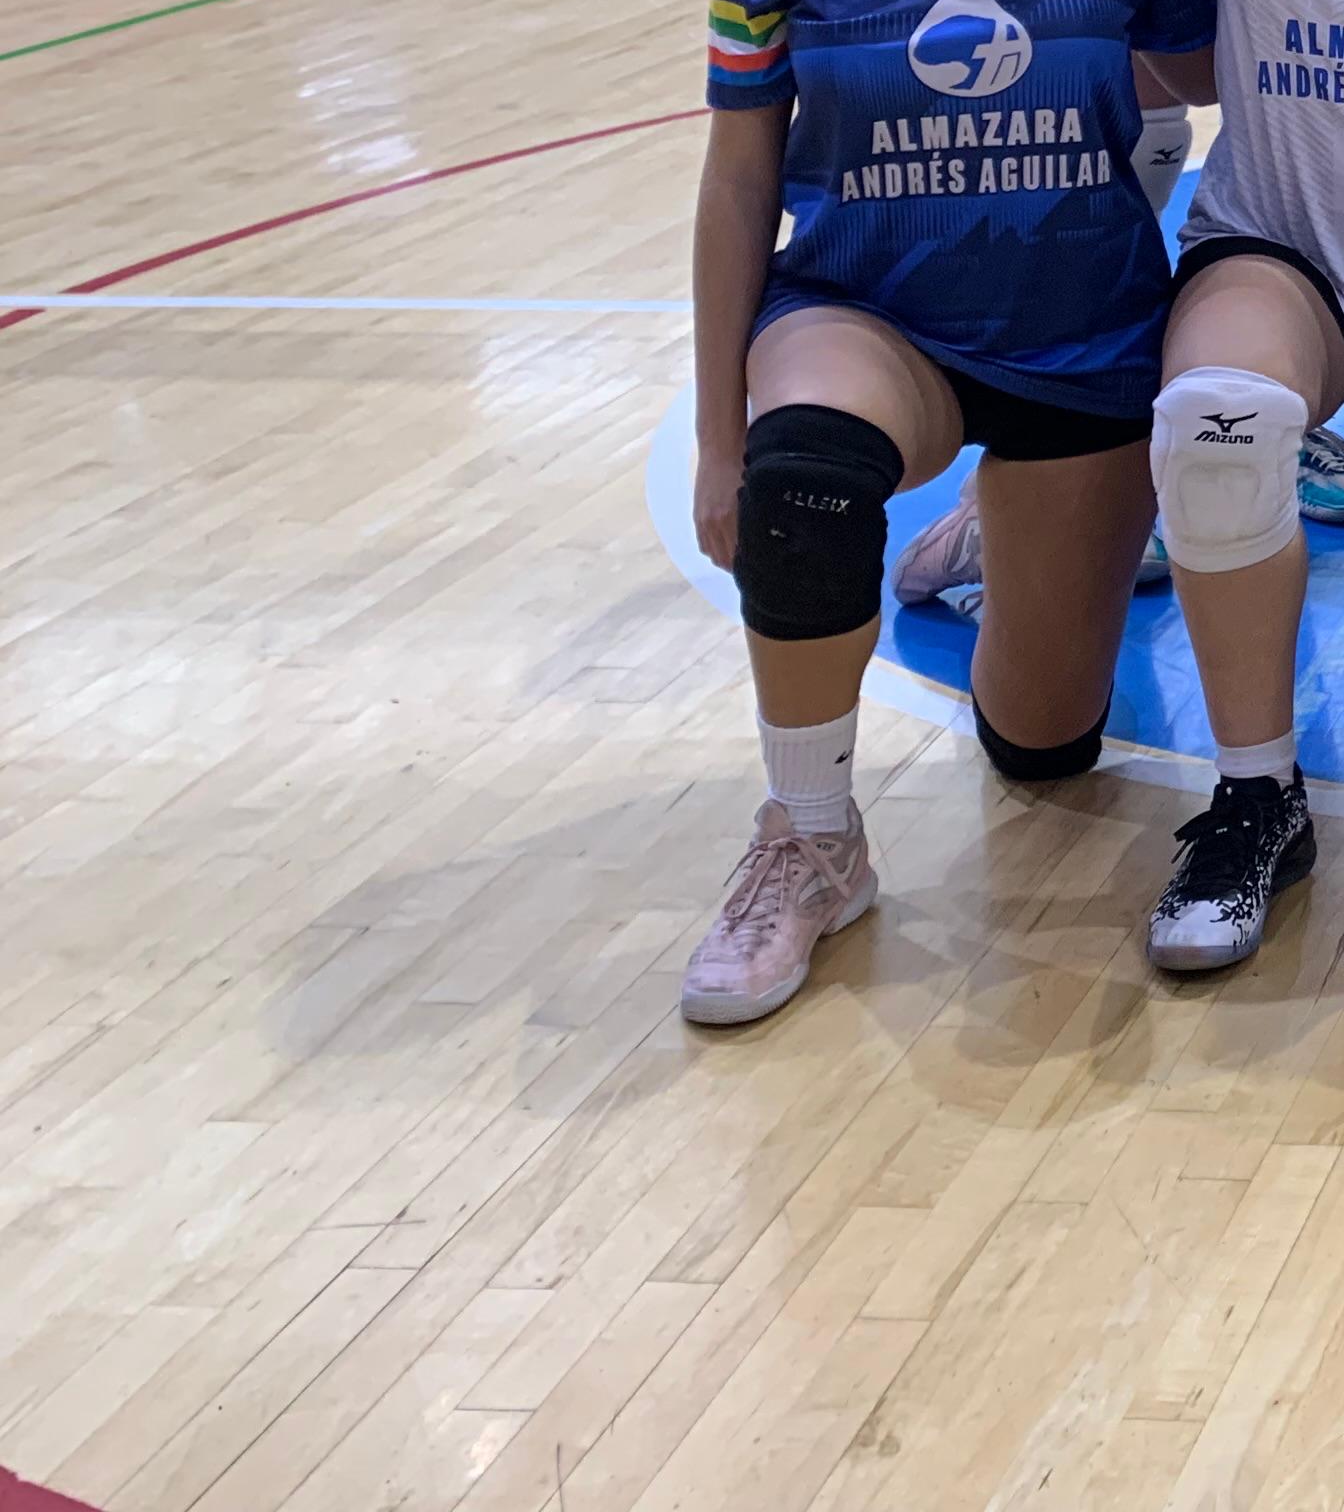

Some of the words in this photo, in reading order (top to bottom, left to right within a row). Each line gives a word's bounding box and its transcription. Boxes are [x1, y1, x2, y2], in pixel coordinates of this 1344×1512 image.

[872, 107, 1083, 155] ALMAZARA
[840, 151, 967, 203] ANDRÉS
[979, 149, 1111, 193] AGUILAR
